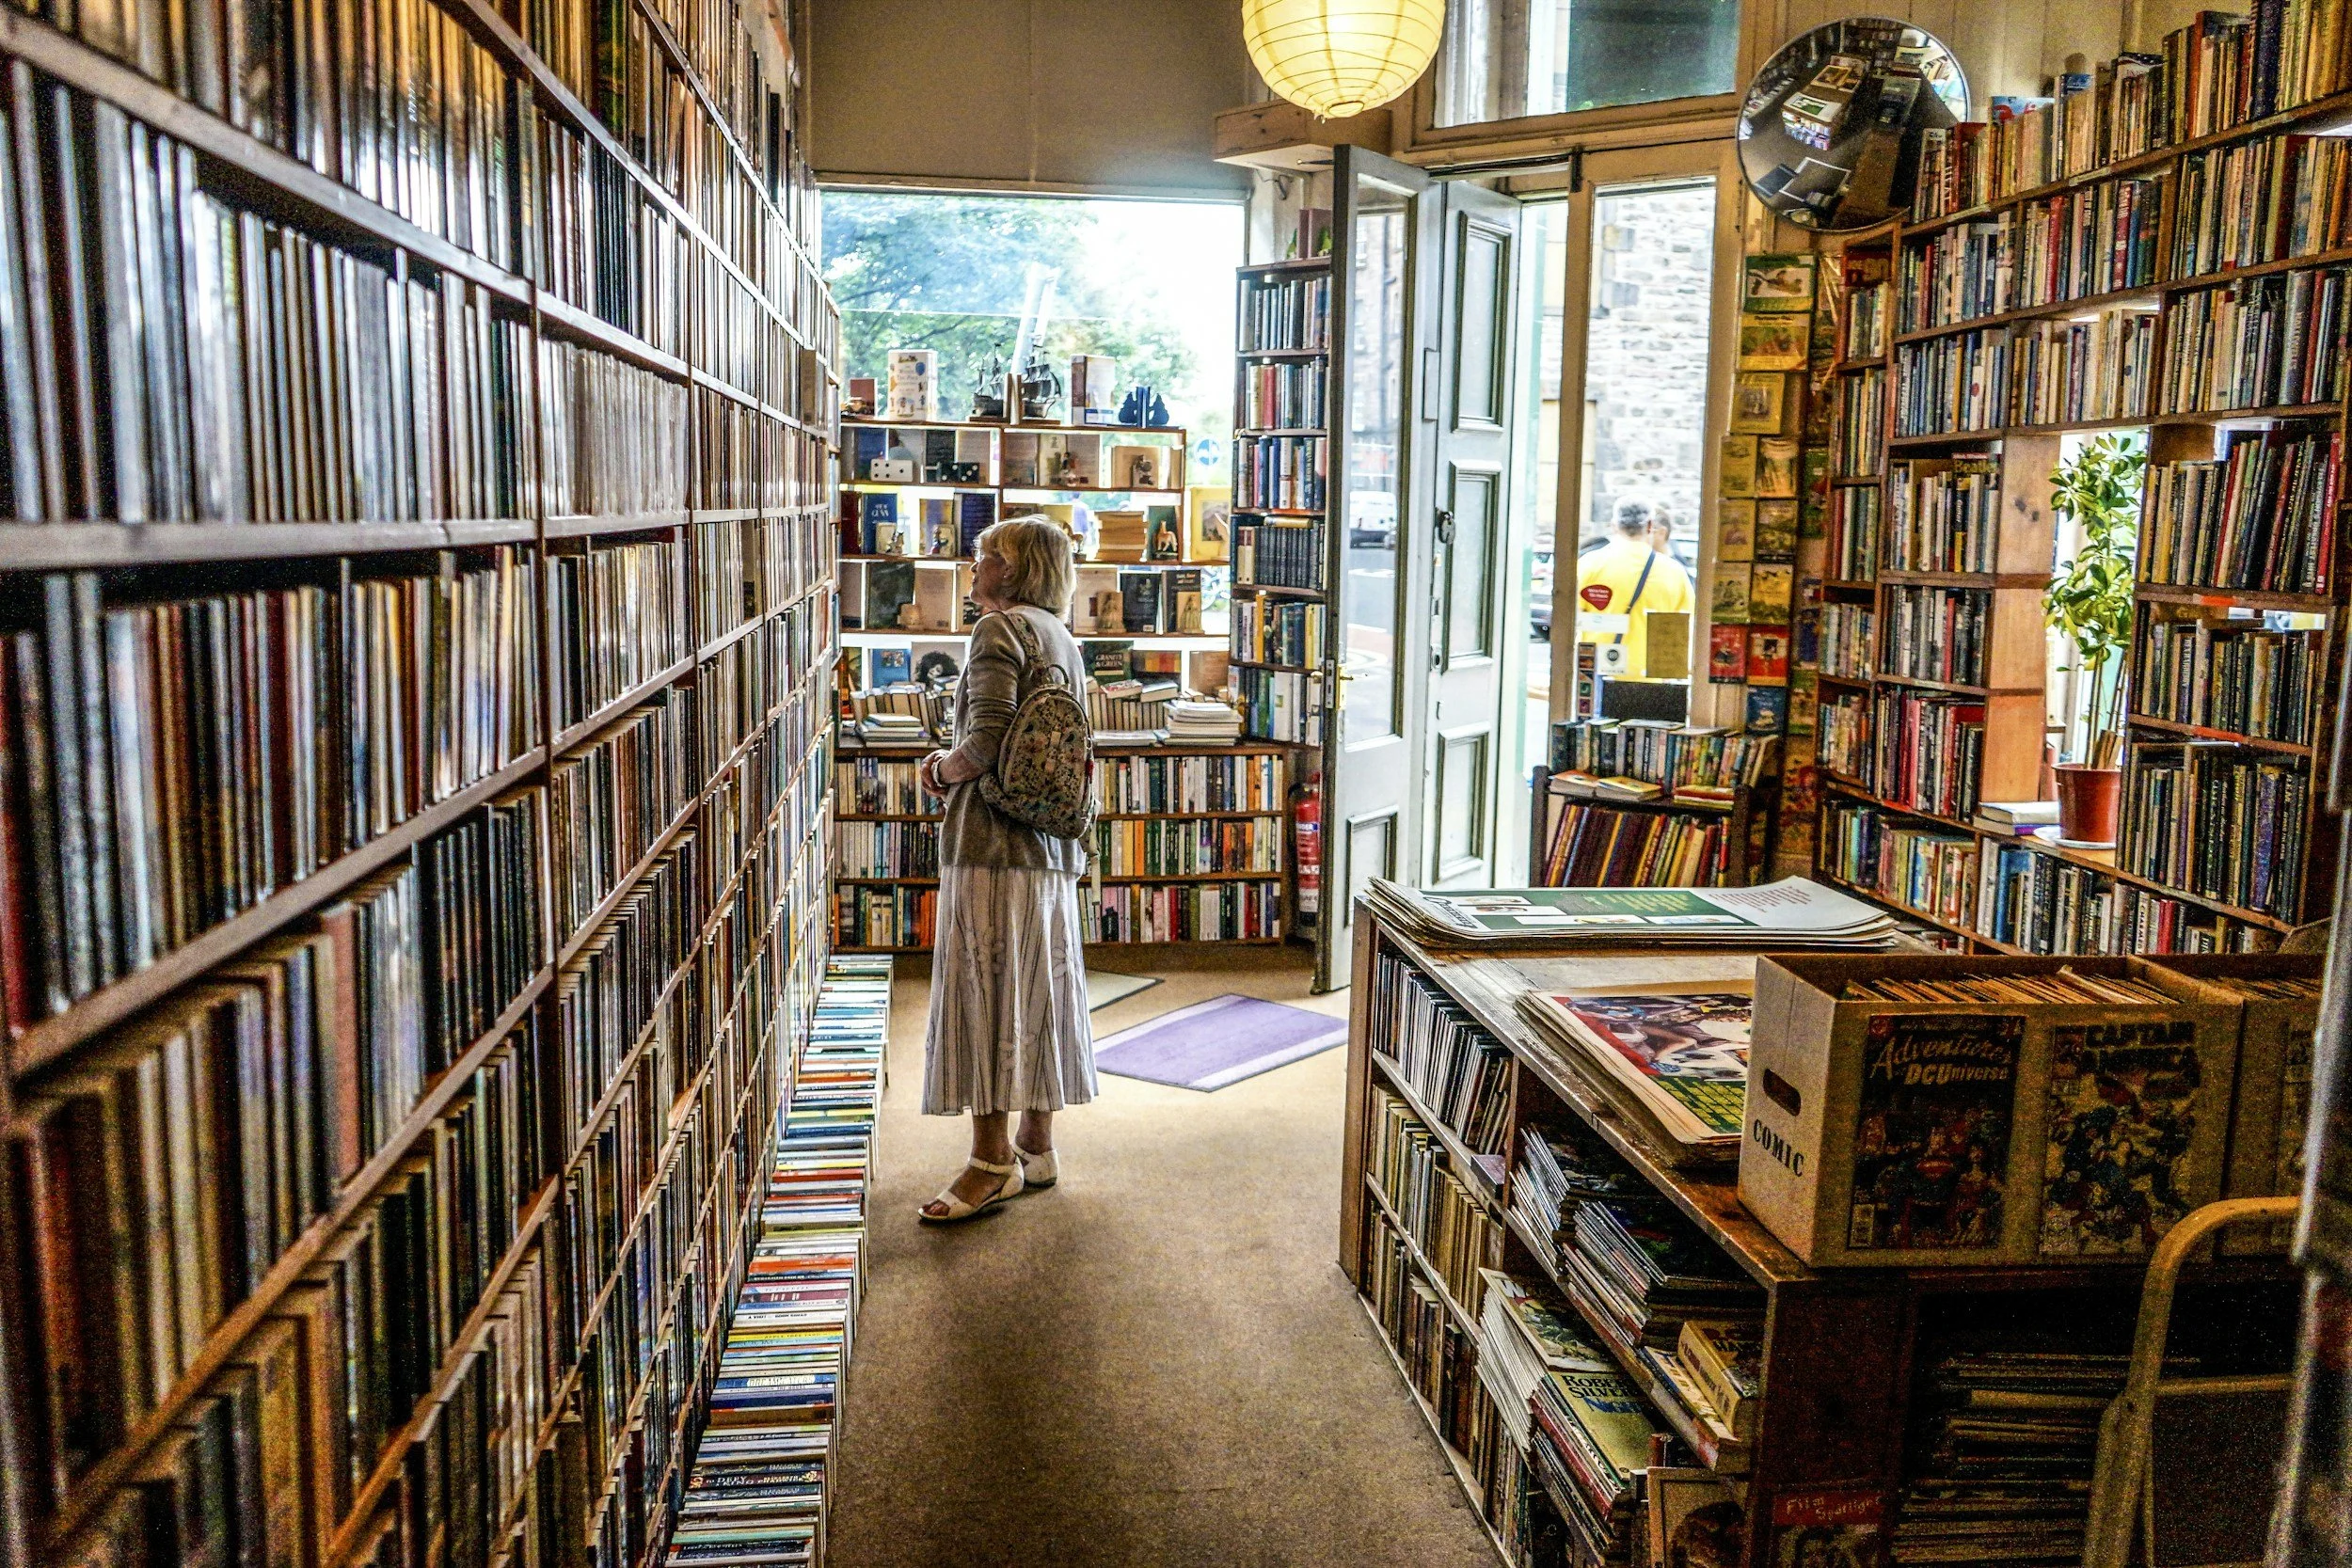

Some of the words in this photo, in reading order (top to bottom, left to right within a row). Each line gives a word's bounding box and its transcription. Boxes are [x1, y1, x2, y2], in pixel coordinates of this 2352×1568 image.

[1753, 1118, 1804, 1178] COMIC
[1561, 1374, 1628, 1388] ROBER
[1568, 1386, 1631, 1399] SILVER
